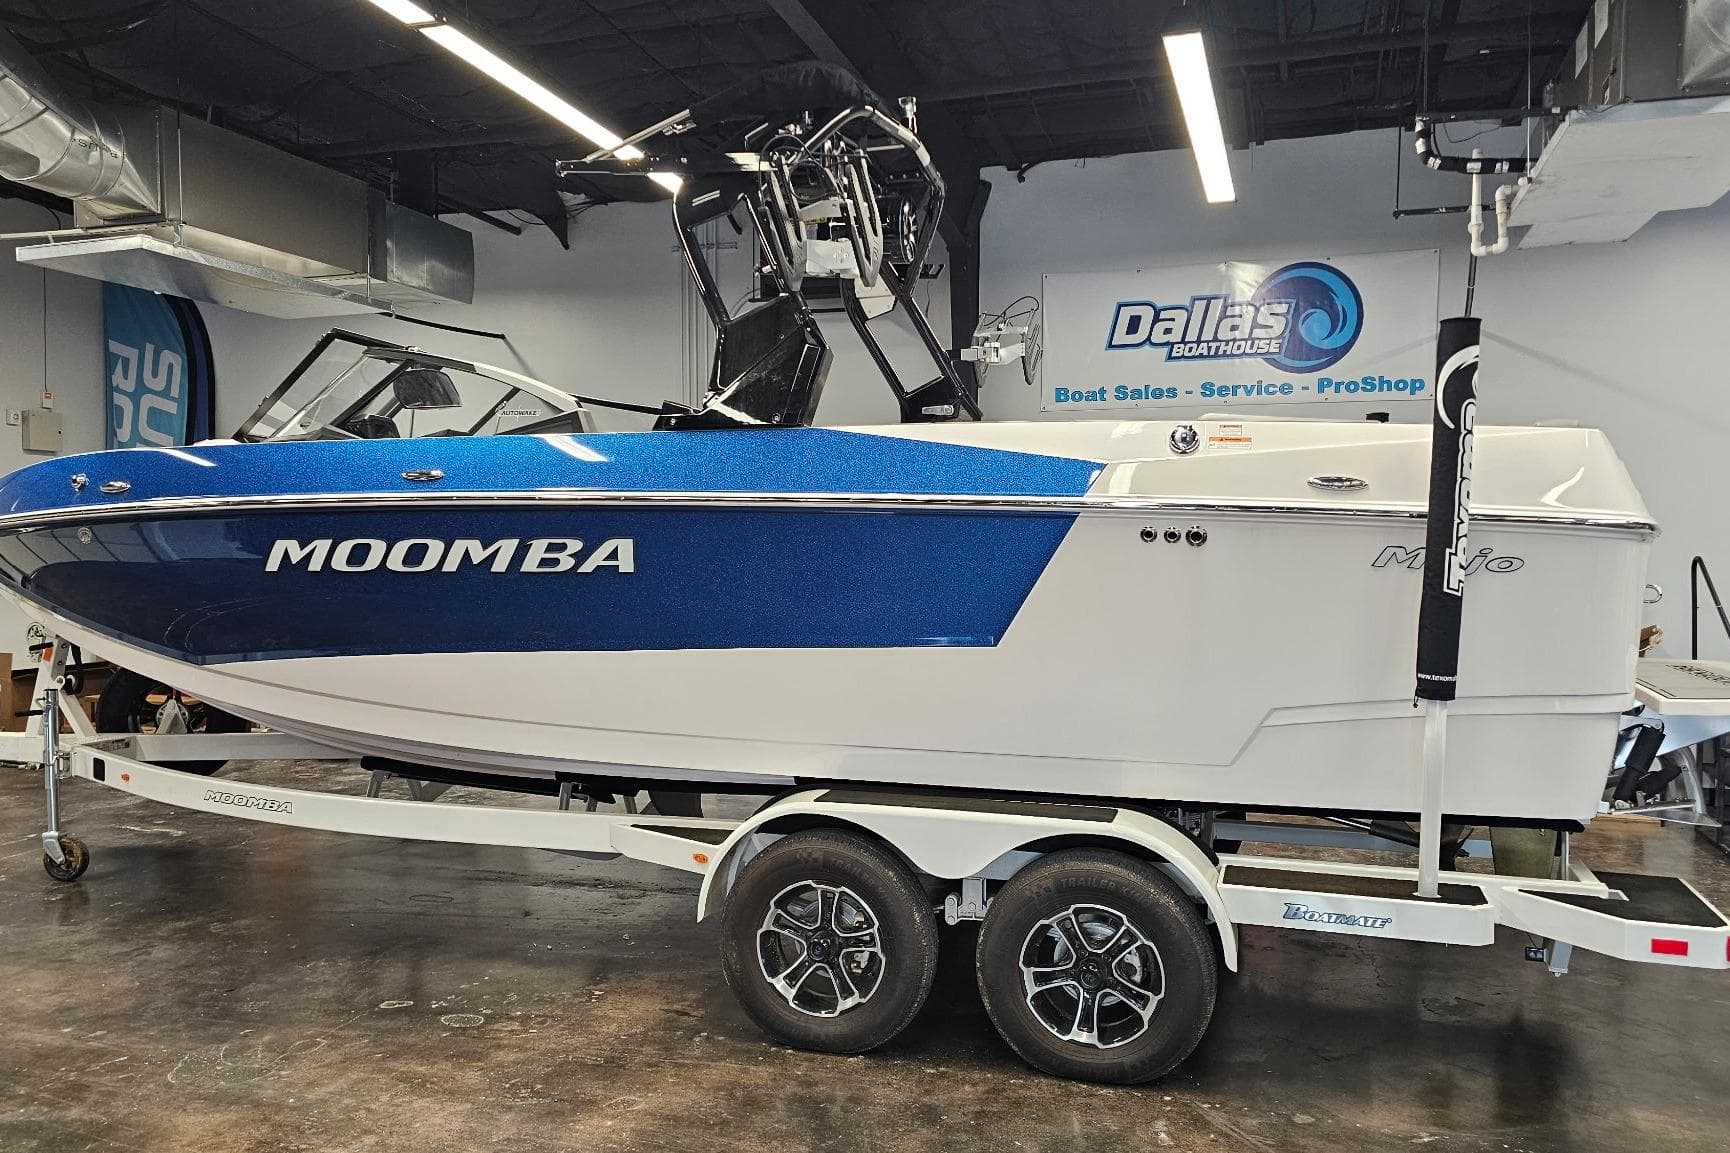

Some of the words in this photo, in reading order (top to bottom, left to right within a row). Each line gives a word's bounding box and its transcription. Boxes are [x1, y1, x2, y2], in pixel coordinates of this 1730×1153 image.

[1111, 298, 1290, 346] Dallas
[1171, 339, 1281, 357] BOATHOUSE
[1055, 386, 1107, 403] Boat
[1114, 384, 1178, 401] Sales
[1200, 379, 1293, 398] Service
[1317, 375, 1426, 396] ProShop
[265, 537, 635, 573] MOOMBA
[1371, 546, 1525, 577] Mjo
[204, 789, 293, 814] MOOMBA
